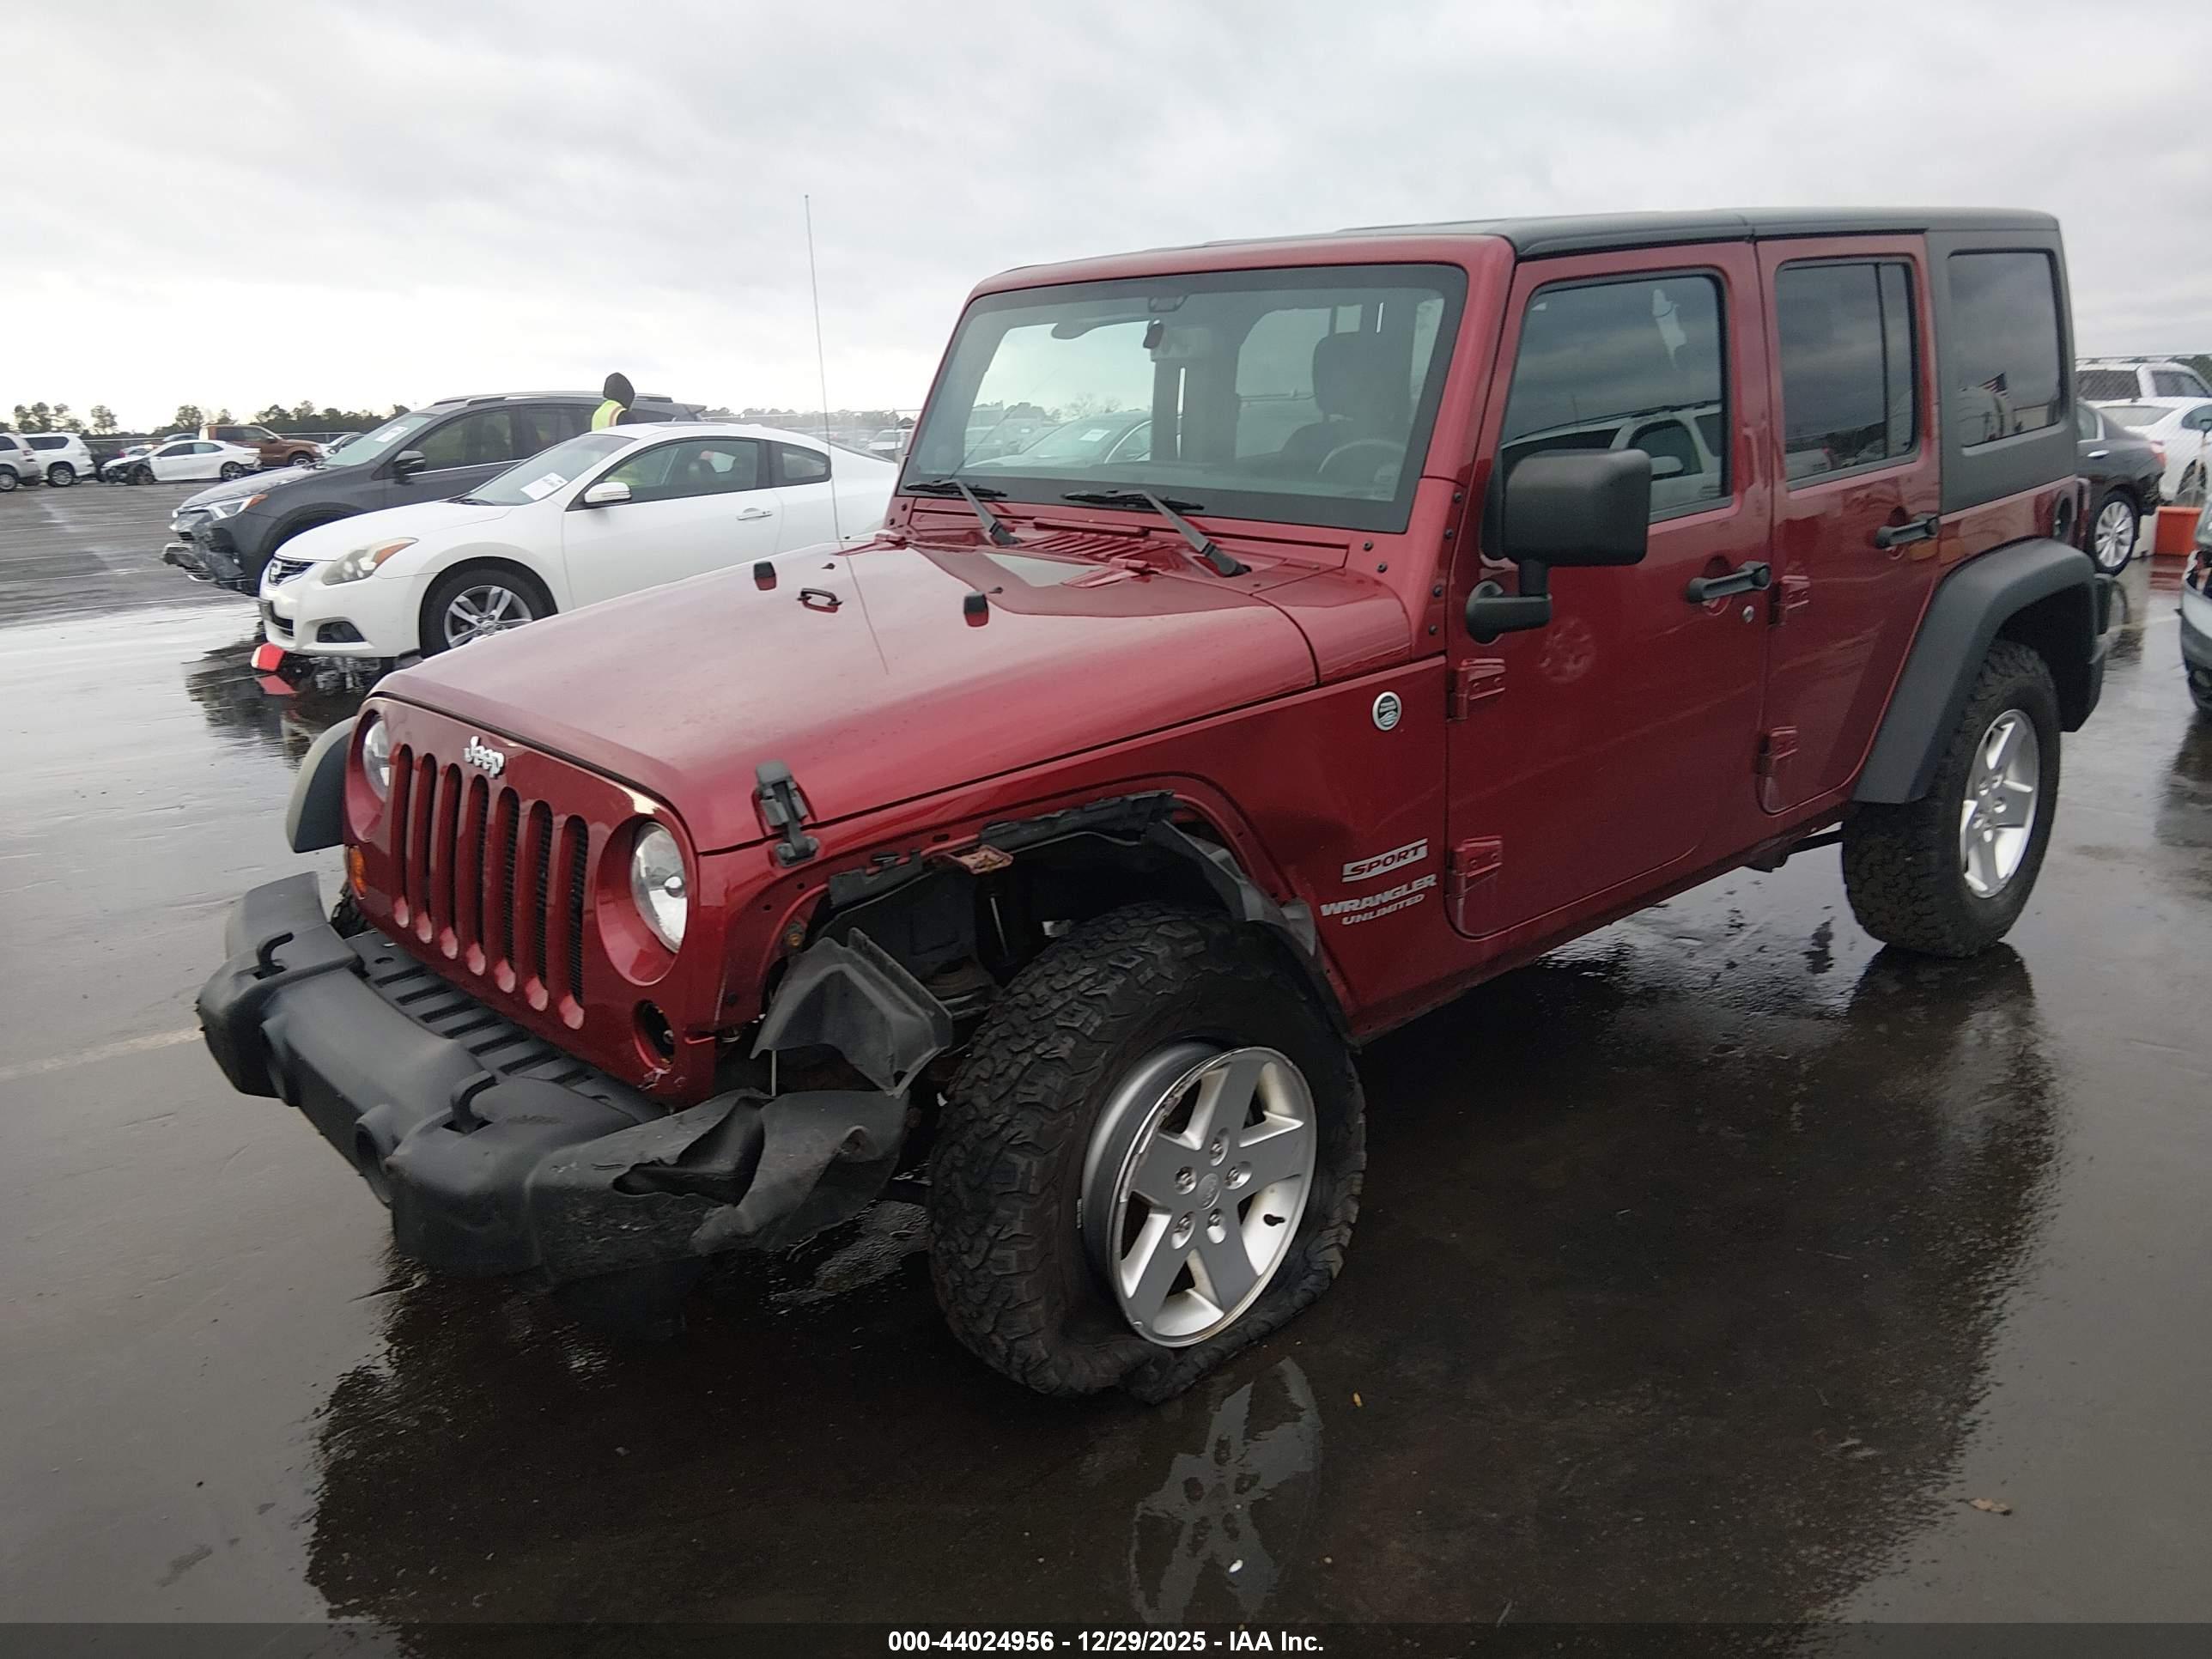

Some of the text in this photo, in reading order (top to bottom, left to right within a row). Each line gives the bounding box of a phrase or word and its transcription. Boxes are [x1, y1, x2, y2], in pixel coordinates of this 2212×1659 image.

[464, 736, 504, 778] Jeep
[1343, 843, 1427, 878] SPORT
[1320, 873, 1437, 916] WRANGLER
[1341, 894, 1425, 925] UNLIMITED
